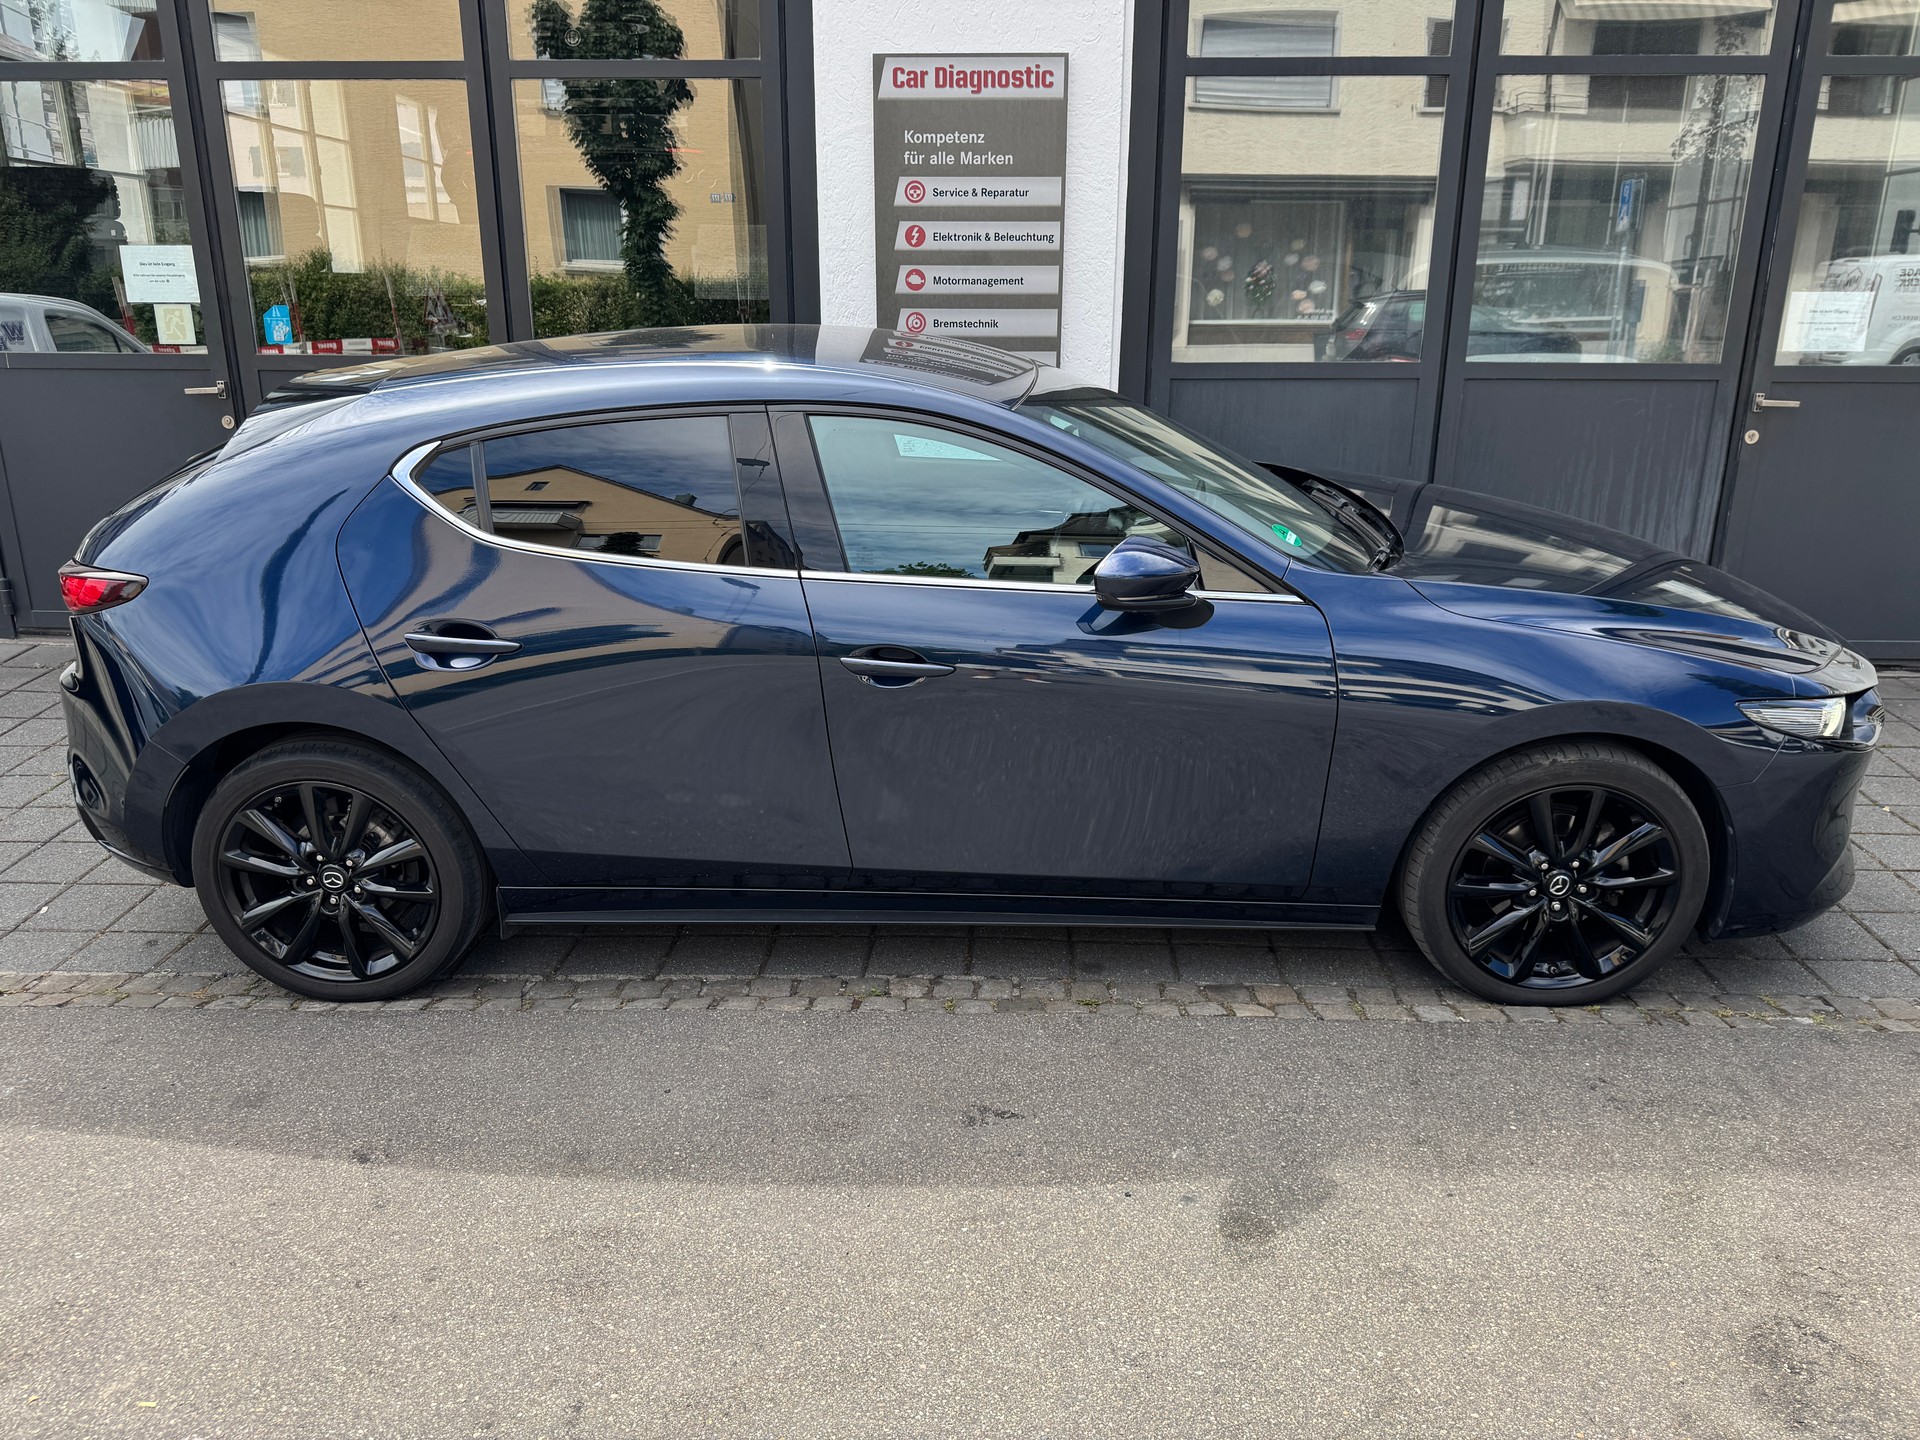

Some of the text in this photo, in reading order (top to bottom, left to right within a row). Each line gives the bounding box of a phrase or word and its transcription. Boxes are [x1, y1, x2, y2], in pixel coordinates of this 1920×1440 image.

[892, 64, 1054, 94] Car Diagnostic
[904, 130, 985, 147] Kompetenz
[903, 151, 1014, 165] für alle Marken
[932, 188, 1030, 199] Service & Reparatur
[933, 232, 1055, 244] Elektronik & Beleuchtung
[933, 276, 1024, 288] Motormanagement
[933, 318, 999, 329] Bremstechnik
